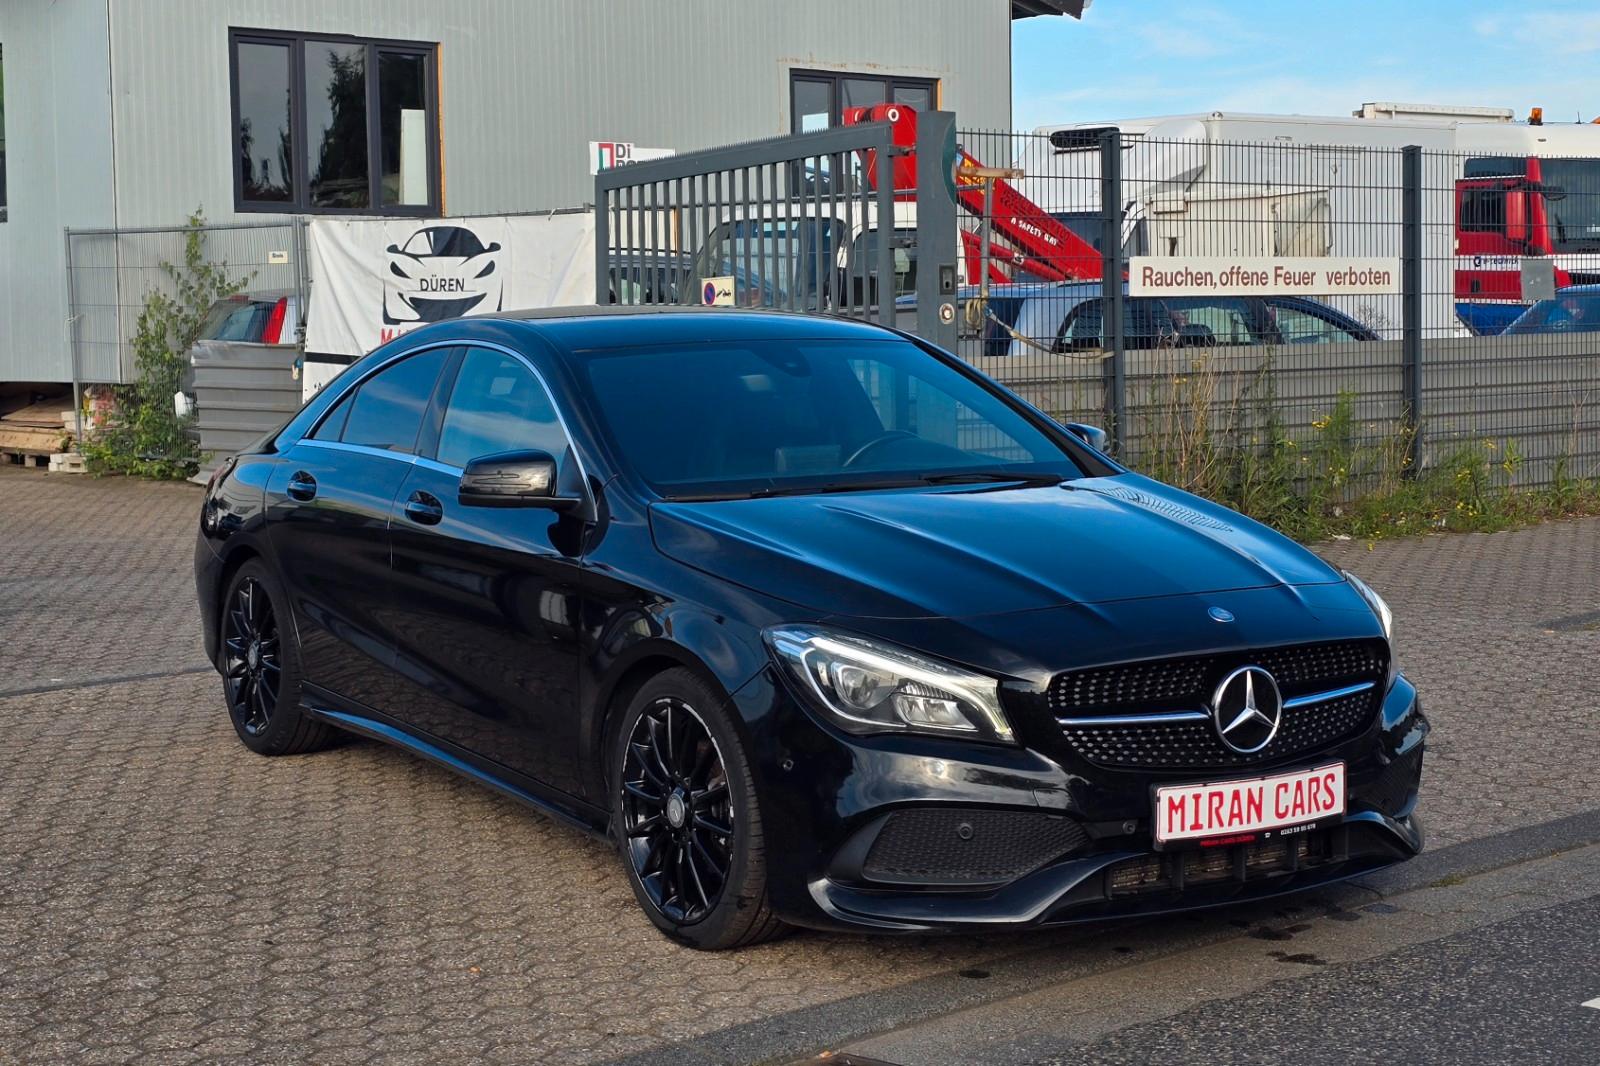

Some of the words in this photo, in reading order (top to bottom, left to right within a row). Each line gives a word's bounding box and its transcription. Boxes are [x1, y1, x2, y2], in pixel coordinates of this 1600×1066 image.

[616, 143, 631, 159] Di
[1018, 220, 1042, 238] SAFETY
[420, 274, 465, 292] DÜREN
[1274, 266, 1316, 286] Feuer
[1326, 266, 1391, 286] verboten
[1167, 786, 1264, 833] MIRAN
[1274, 773, 1336, 819] CARS
